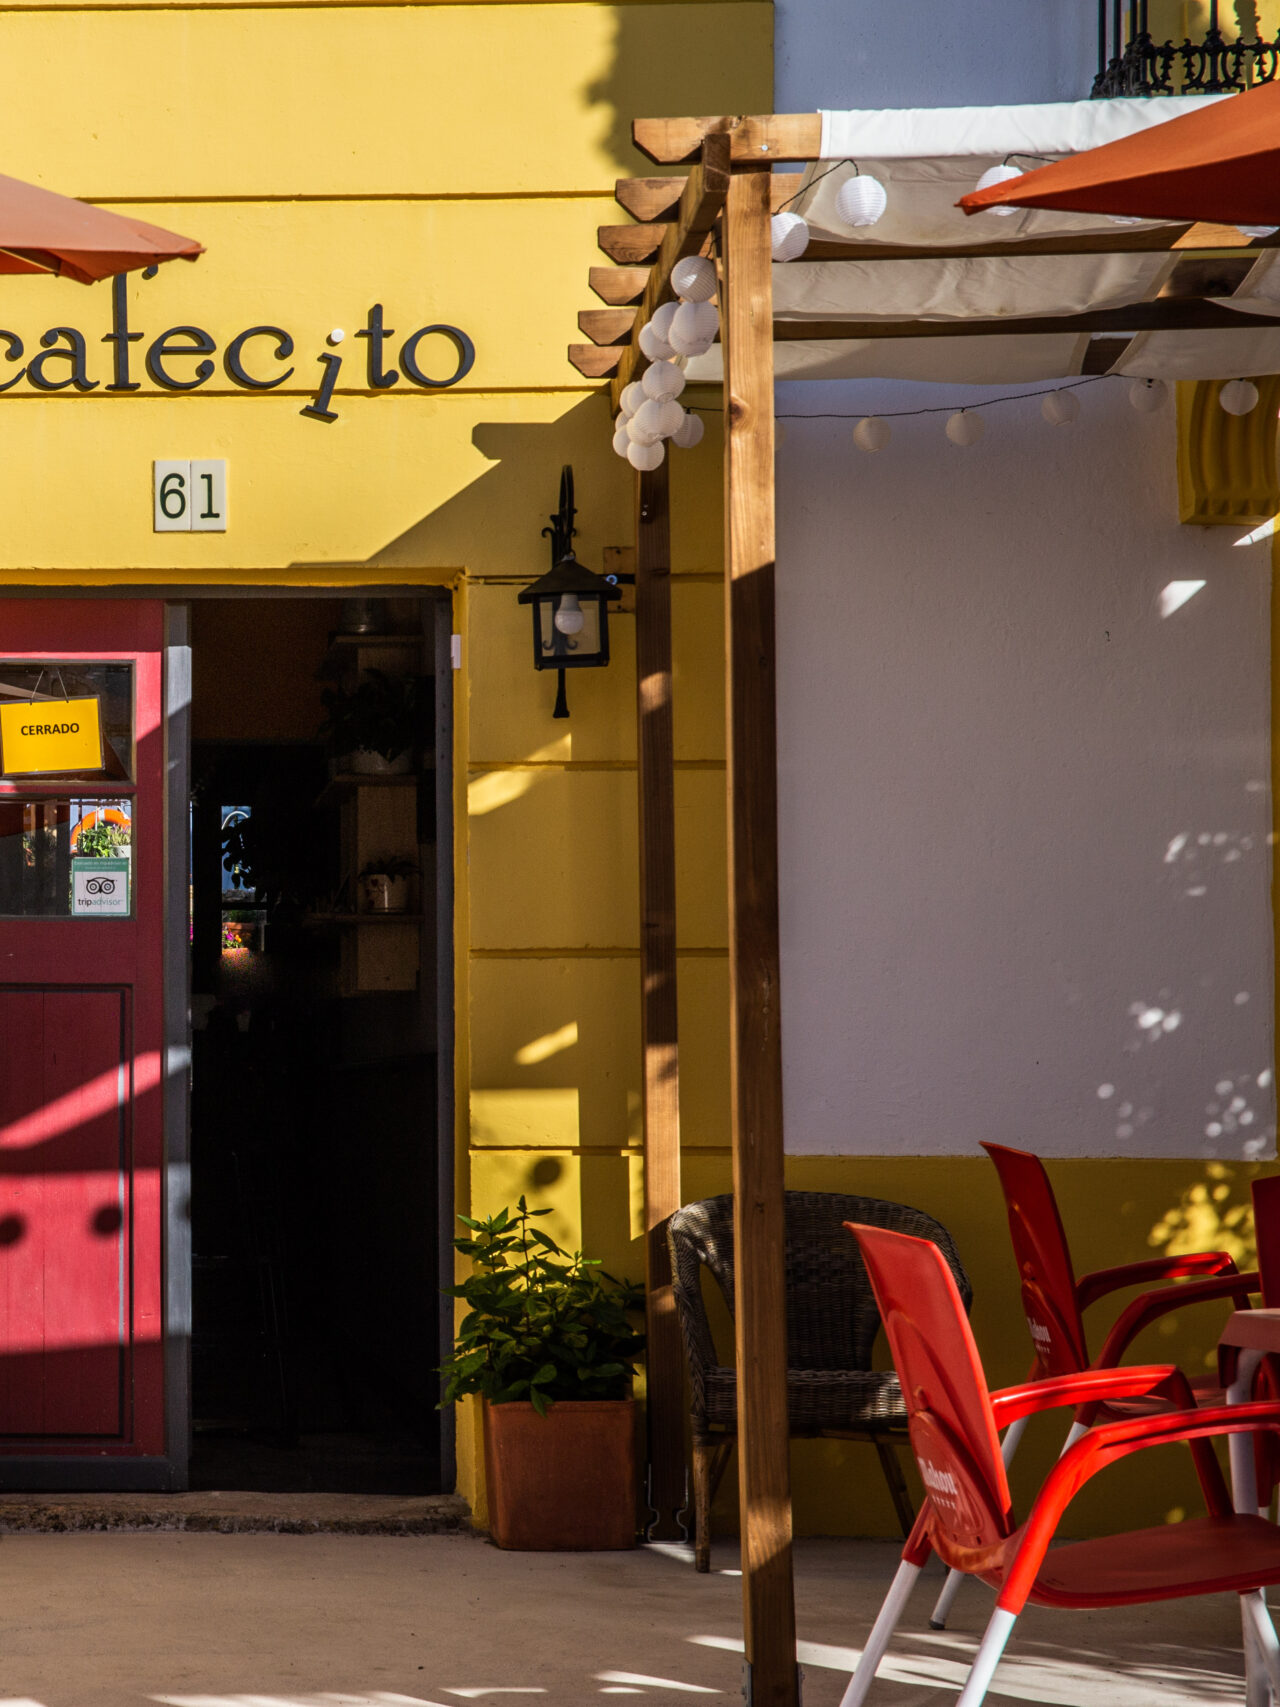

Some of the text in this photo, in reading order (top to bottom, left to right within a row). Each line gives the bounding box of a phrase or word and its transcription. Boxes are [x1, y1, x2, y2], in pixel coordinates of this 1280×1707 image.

[160, 474, 220, 520] 61
[20, 722, 80, 737] CERRADO
[77, 898, 121, 908] tripadvisor
